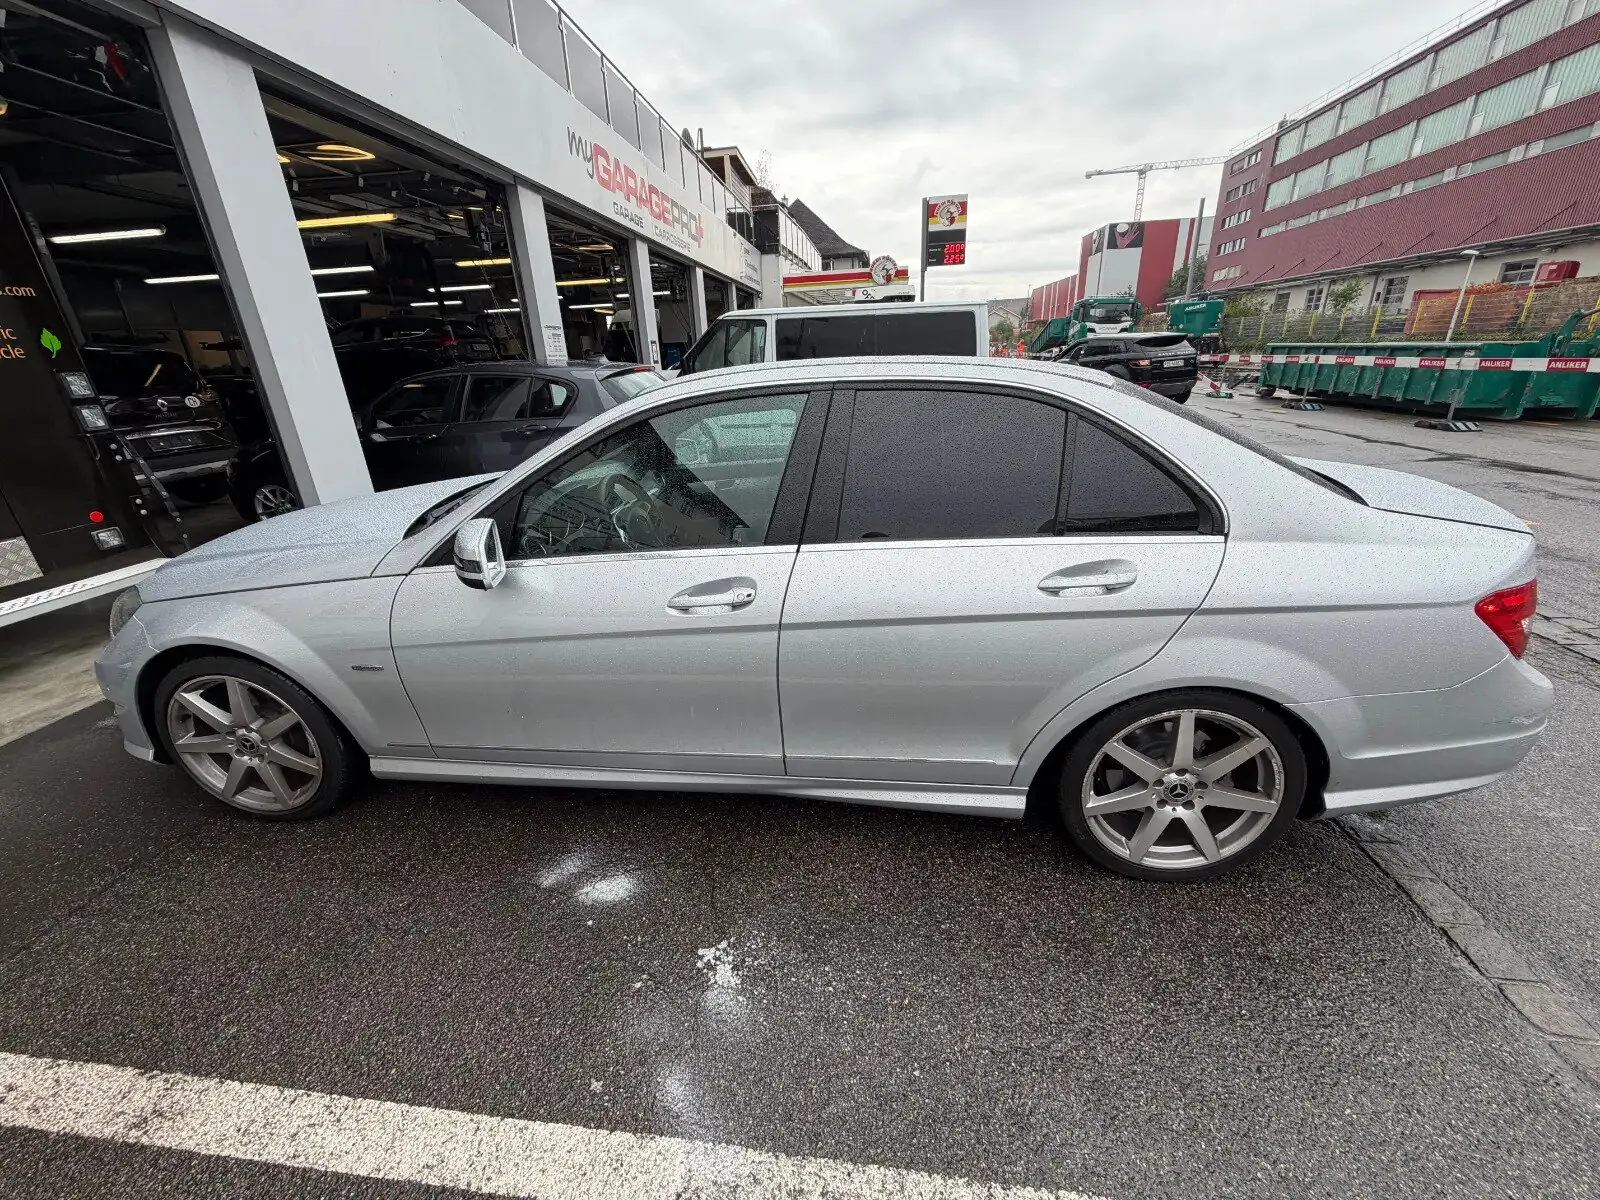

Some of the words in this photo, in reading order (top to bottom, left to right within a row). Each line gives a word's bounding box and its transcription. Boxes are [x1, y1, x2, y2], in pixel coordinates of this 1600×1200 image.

[612, 201, 644, 229] GARAGE
[0, 326, 17, 340] ic
[1480, 360, 1511, 368] ANLIKER
[1548, 361, 1588, 369] ANLIKER
[187, 397, 199, 407] CH
